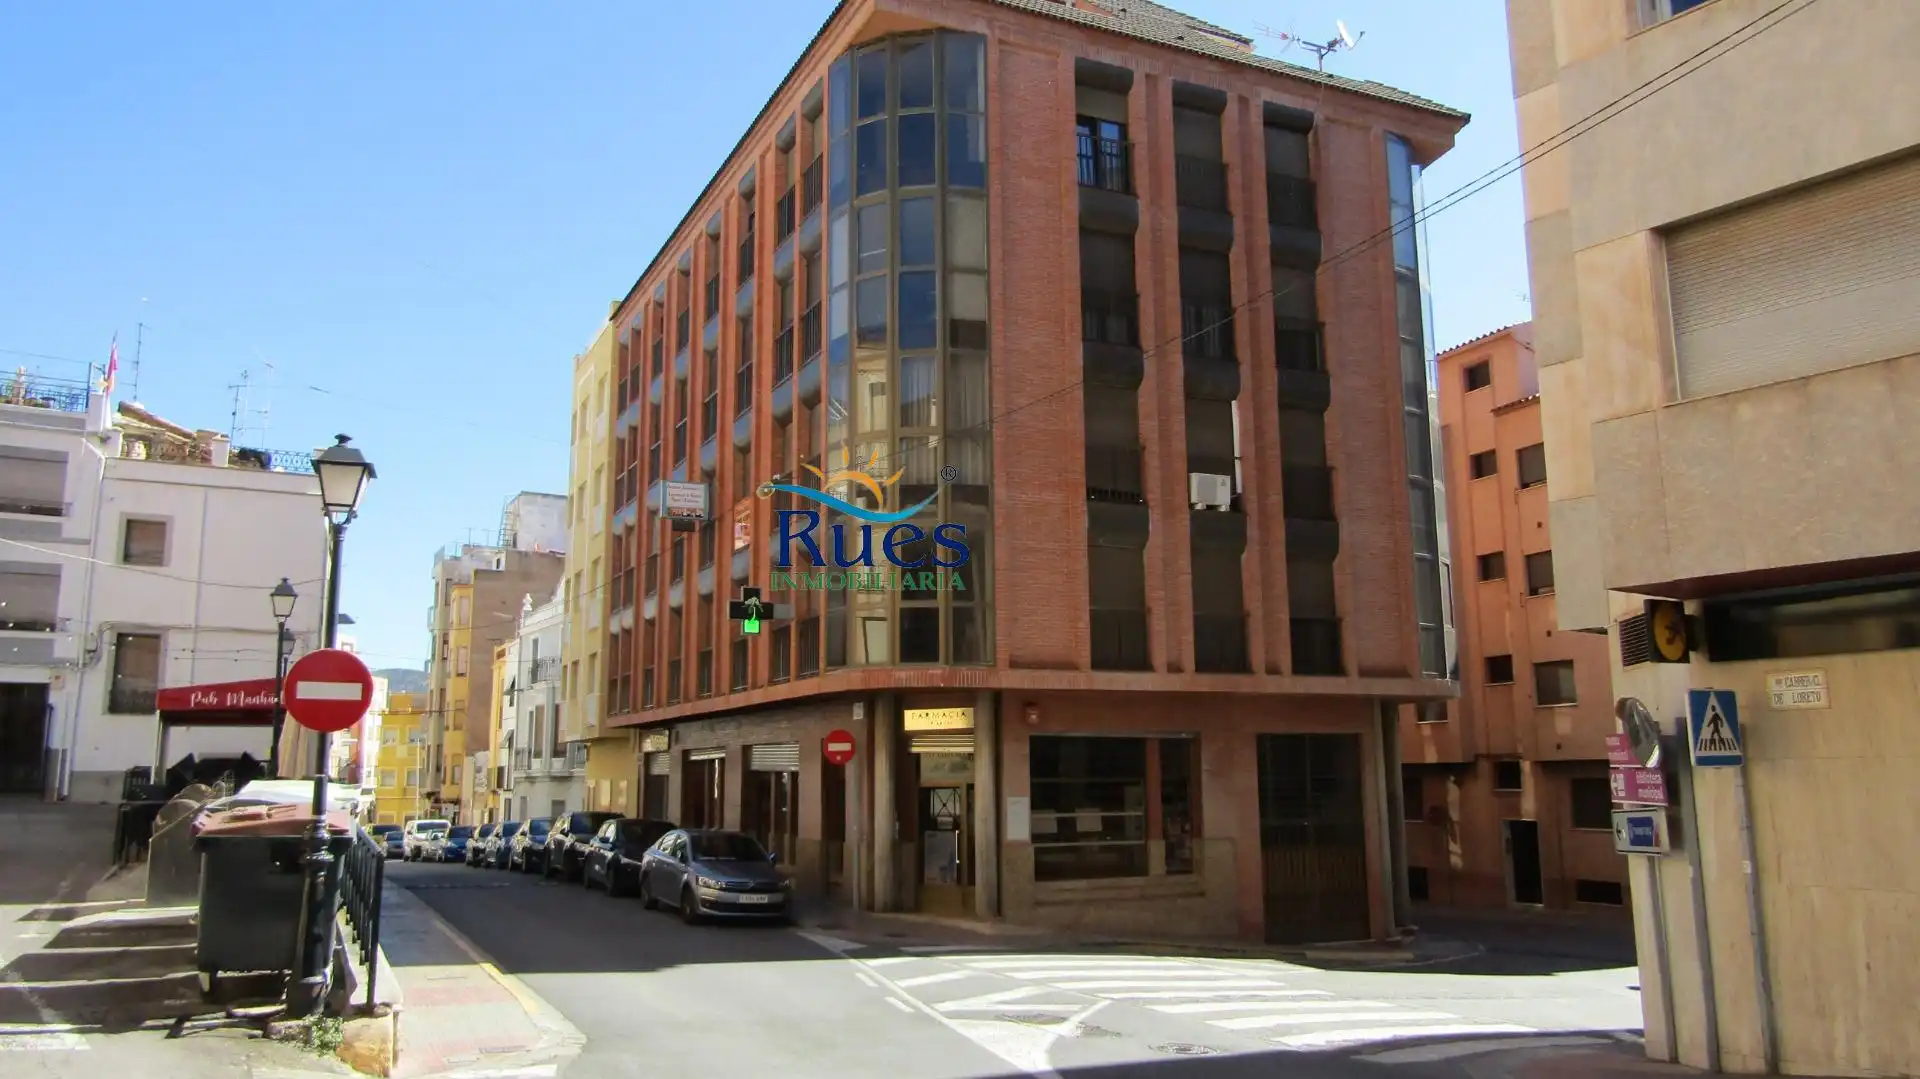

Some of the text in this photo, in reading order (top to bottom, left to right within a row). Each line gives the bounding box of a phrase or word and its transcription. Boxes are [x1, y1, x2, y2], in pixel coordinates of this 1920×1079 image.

[190, 691, 218, 707] Pub
[1791, 691, 1821, 703] LORETO
[911, 711, 968, 720] FARMACIA
